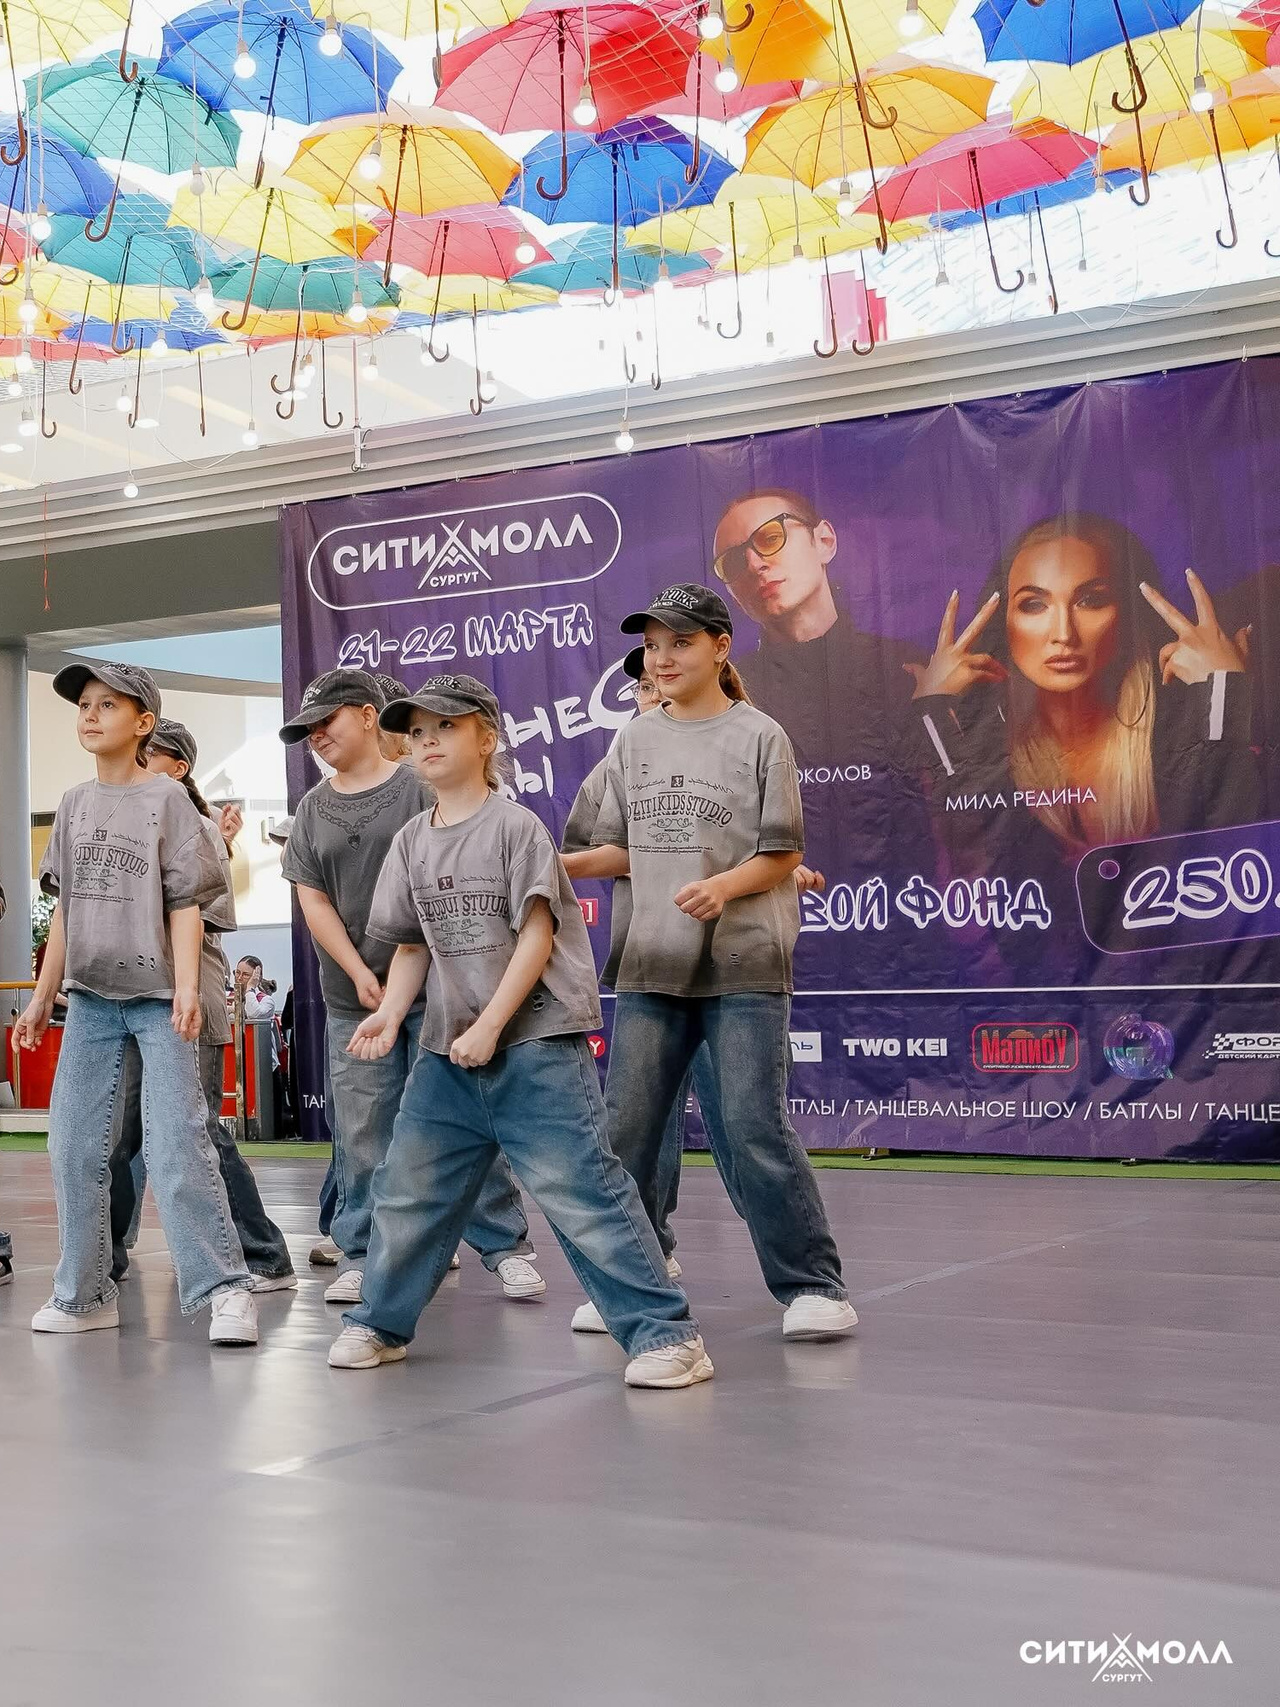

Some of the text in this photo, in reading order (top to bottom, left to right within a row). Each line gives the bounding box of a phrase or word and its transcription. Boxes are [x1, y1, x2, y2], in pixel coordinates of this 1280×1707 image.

[332, 513, 594, 576] СИТИ МОЛЛ
[429, 570, 480, 588] СУРГУТ
[336, 602, 594, 671] 21-22 МАРТА
[945, 787, 1098, 812] МИЛА РЕДИНА
[895, 875, 1052, 932] ФОНД
[1122, 847, 1280, 930] 250
[842, 1037, 948, 1057] TWO KEI
[854, 1099, 1017, 1118] ТАНЦЕВАЛЬНОЕ
[1022, 1100, 1077, 1119] ШОУ
[1100, 1101, 1182, 1120] БАТТЛЫ
